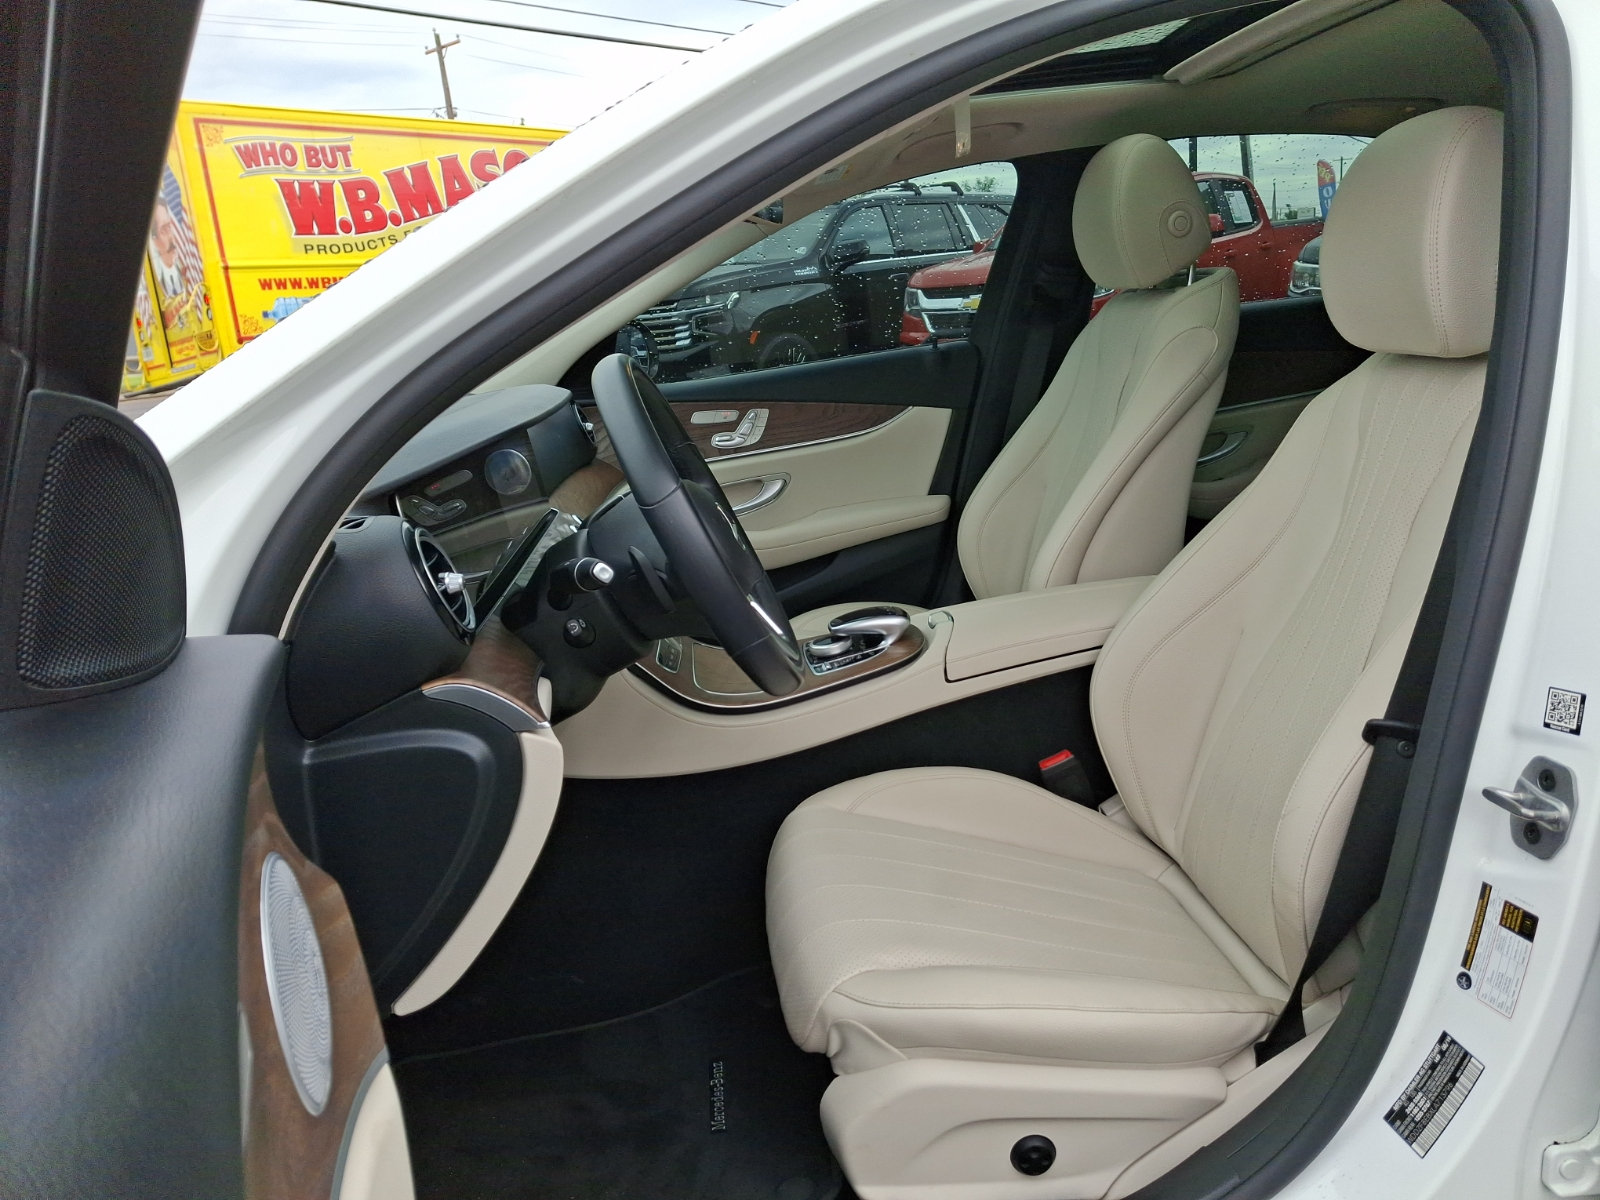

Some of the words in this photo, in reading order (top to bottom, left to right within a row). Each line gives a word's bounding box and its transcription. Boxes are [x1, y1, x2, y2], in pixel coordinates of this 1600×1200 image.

[234, 143, 298, 170] WHO
[303, 144, 352, 169] BUT
[304, 234, 398, 254] PRODUCTS
[711, 1061, 725, 1131] Mercedes-Benz
